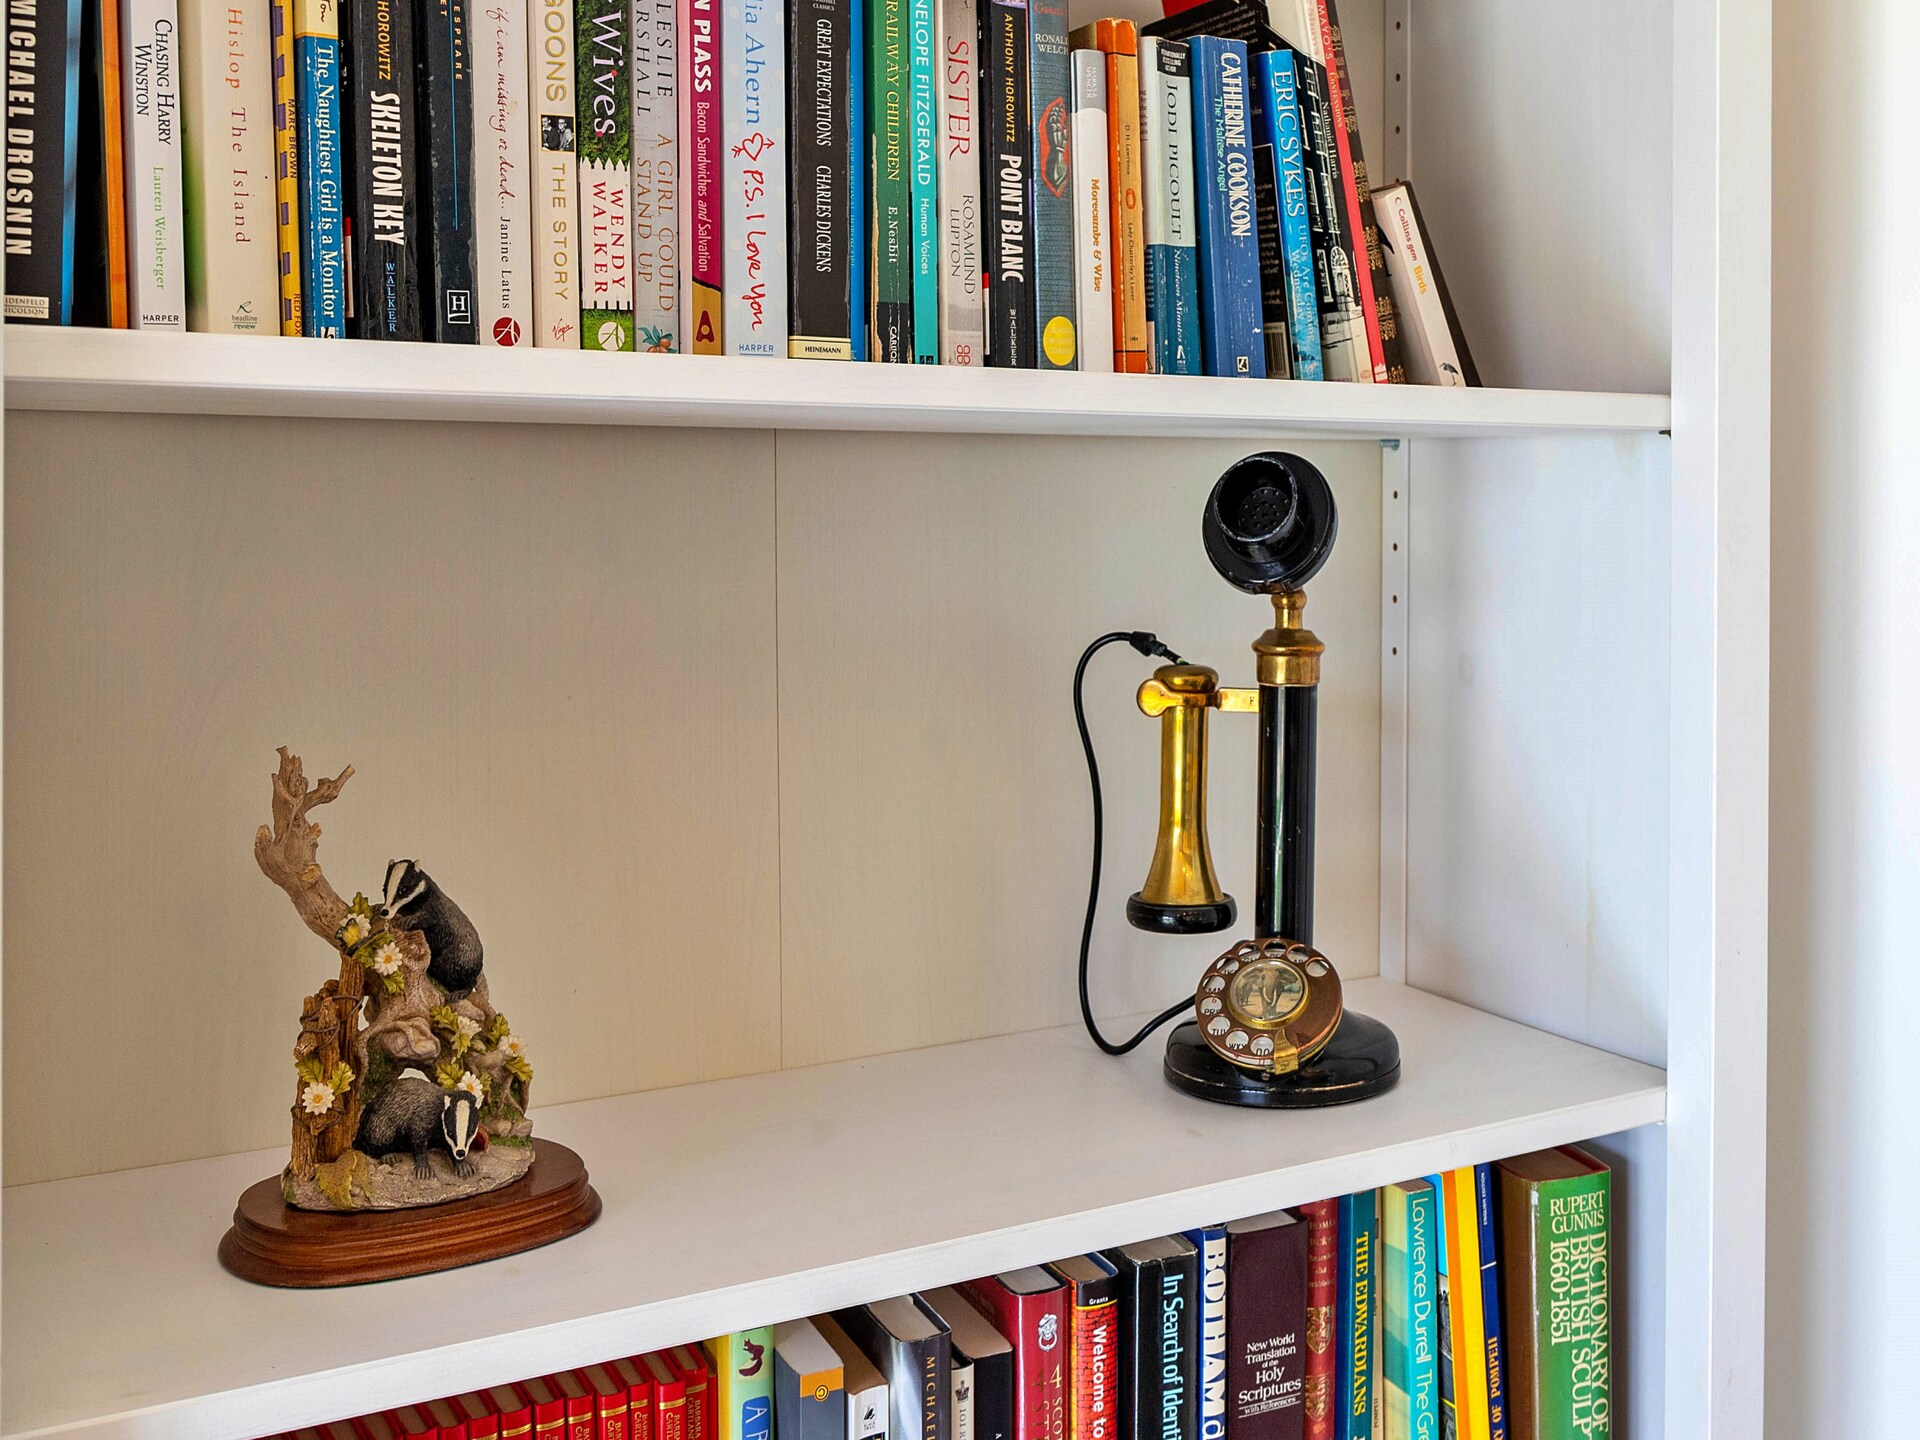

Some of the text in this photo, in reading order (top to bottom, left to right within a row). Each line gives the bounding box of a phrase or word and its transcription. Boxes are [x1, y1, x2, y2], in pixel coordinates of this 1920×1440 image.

[376, 0, 392, 81] HOROWITZ
[485, 6, 510, 24] if
[656, 2, 674, 97] LESLIE
[816, 18, 833, 58] GREAT
[1317, 4, 1334, 60] MAYO'S
[135, 43, 153, 117] WINSTON
[154, 18, 175, 146] CHASING HARRY
[316, 44, 335, 79] The
[496, 40, 505, 69] am
[592, 9, 625, 135] Wives
[636, 0, 652, 117] RSHALL
[693, 19, 713, 94] PLASS
[745, 32, 766, 125] Ahern
[885, 0, 900, 181] RAILWAY CHILDREN
[1004, 13, 1016, 143] ANTHONY HOROWITZ
[5, 0, 37, 256] MICHAEL DROSNIN
[225, 7, 251, 243] Hislop The Island
[314, 83, 336, 175] Naughtiest
[488, 72, 512, 134] missing
[816, 58, 832, 147] EXPECTATIONS
[915, 74, 932, 187] FITZGERALD
[947, 35, 971, 161] SISTER
[1329, 71, 1343, 128] CONFESSIONS
[287, 98, 298, 179] MARC BROWN
[370, 90, 406, 246] SKELETON KEY
[498, 137, 508, 151] or
[1166, 80, 1182, 240] JODI PICOULT
[1214, 96, 1229, 192] The Maltese Angel
[1220, 52, 1252, 237] CATHERINE COOKSON
[1273, 70, 1306, 218] ERIC SYKES
[1321, 101, 1338, 180] Nathaniel Harris
[319, 179, 338, 213] Girl
[321, 217, 338, 231] is
[636, 157, 654, 284] STAND UP
[657, 133, 675, 312] A GIRL COULD
[696, 101, 713, 273] Bacon Sandwiches and Salvation
[815, 165, 832, 273] CHARLES DICKENS
[1000, 153, 1025, 283] POINT BLANC
[153, 167, 168, 290] Lauren Weisberger
[320, 235, 333, 245] a
[500, 216, 512, 263] Janine
[551, 162, 569, 301] THE STORY
[592, 181, 609, 294] WALKER
[609, 188, 627, 289] WENDY
[741, 169, 767, 332] P.S. I Love You
[920, 197, 931, 275] Human Voices
[950, 208, 961, 278] LUPTON
[962, 194, 977, 295] ROSAMUND
[1090, 178, 1103, 292] Morecambe & Wise
[1126, 222, 1134, 238] Lady
[1127, 239, 1135, 280] Chatterley's
[1398, 208, 1428, 295] Collins gem Birds
[142, 314, 180, 323] HARPER
[231, 314, 258, 323] headline
[293, 293, 303, 336] RED FOX
[320, 250, 340, 319] Monitor
[385, 261, 398, 333] WALKER
[500, 269, 512, 309] Latus
[1173, 249, 1185, 343] Nineteen Minutes
[1290, 249, 1304, 321] Wednesday
[1297, 225, 1316, 343] UFOs Are Coming
[233, 322, 256, 330] review
[738, 343, 775, 353] HARPER
[804, 345, 842, 354] HEINEMANN
[1009, 308, 1018, 367] WALKER
[1549, 1189, 1606, 1217] RUPERT
[1551, 1208, 1605, 1235] GUNNIS
[1088, 1296, 1109, 1306] Granta
[1163, 1273, 1184, 1296] In
[1353, 1230, 1369, 1417] THE EDWARDIANS
[1411, 1197, 1433, 1410] Lawrence Durrell The
[1549, 1239, 1572, 1346] 1660-1851
[1570, 1235, 1591, 1344] BRITISH
[1163, 1296, 1184, 1364] Search
[1245, 1345, 1297, 1365] Translation
[1246, 1332, 1296, 1354] New World
[1261, 1359, 1279, 1369] of the
[1487, 1335, 1502, 1399] POMPEII
[1588, 1230, 1610, 1433] DICTIONARY OF
[1092, 1323, 1107, 1439] Welcome to
[1162, 1364, 1184, 1386] of
[1238, 1378, 1302, 1404] Scriptures
[1255, 1366, 1286, 1385] Holy
[1491, 1404, 1502, 1424] OF
